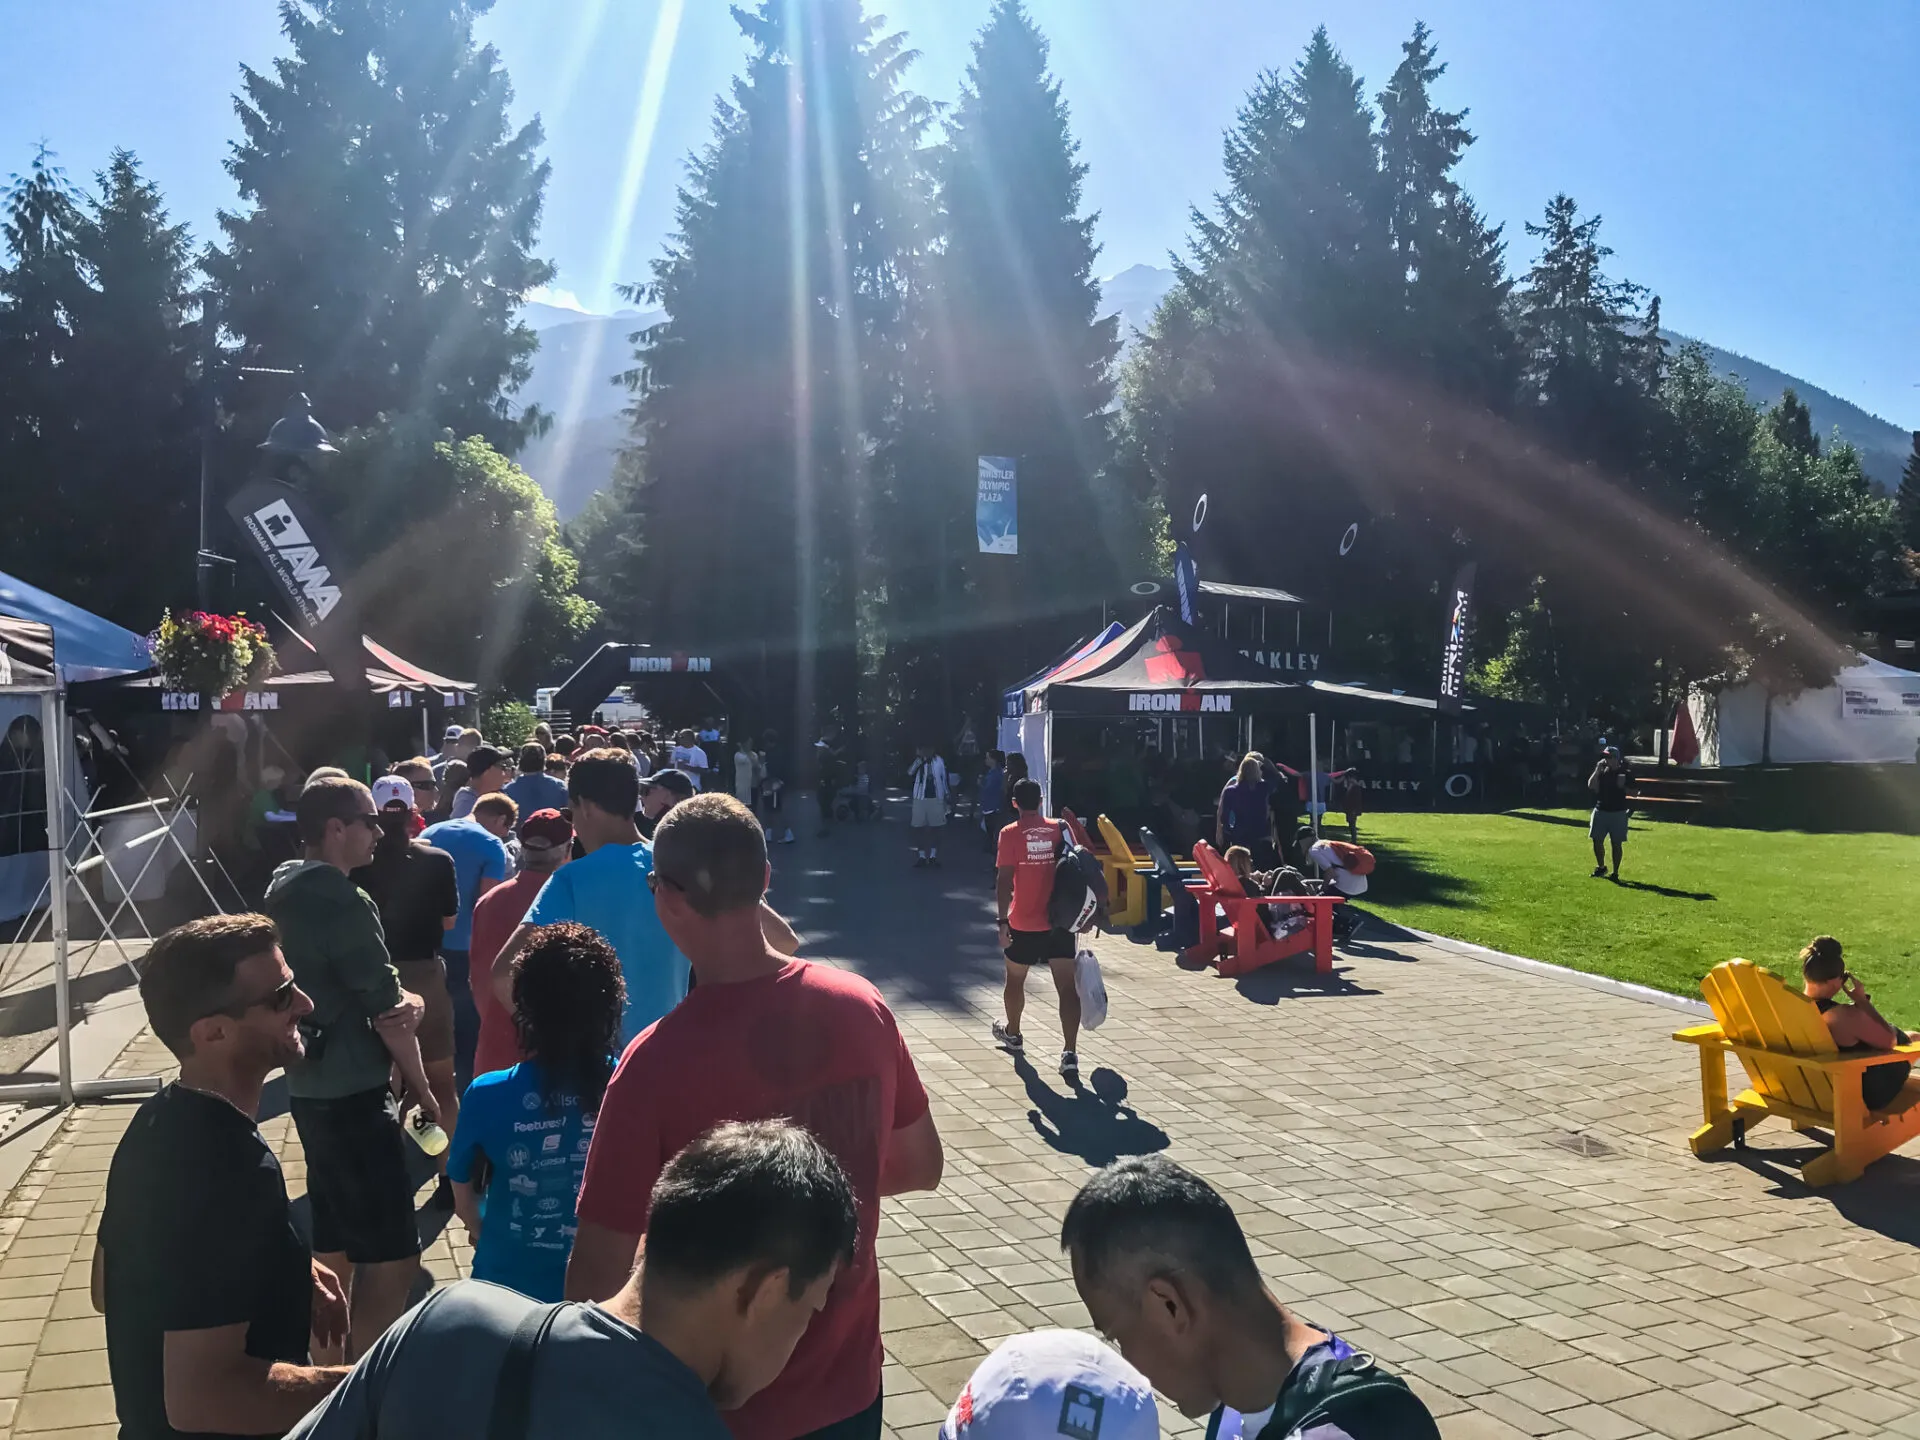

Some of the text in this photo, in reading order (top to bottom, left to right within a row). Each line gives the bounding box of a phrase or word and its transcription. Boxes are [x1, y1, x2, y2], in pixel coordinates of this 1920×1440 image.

[980, 469, 1015, 480] WHISTLER
[979, 481, 1010, 491] OLYMPIC
[978, 492, 1003, 502] PLAZA
[243, 515, 318, 628] IRONMAN ALL WORLD ATHLETE
[1447, 590, 1465, 696] PRIZM
[1129, 688, 1233, 712] IRONMAN
[1343, 779, 1421, 791] AKLEY
[1027, 852, 1055, 860] FINISHER
